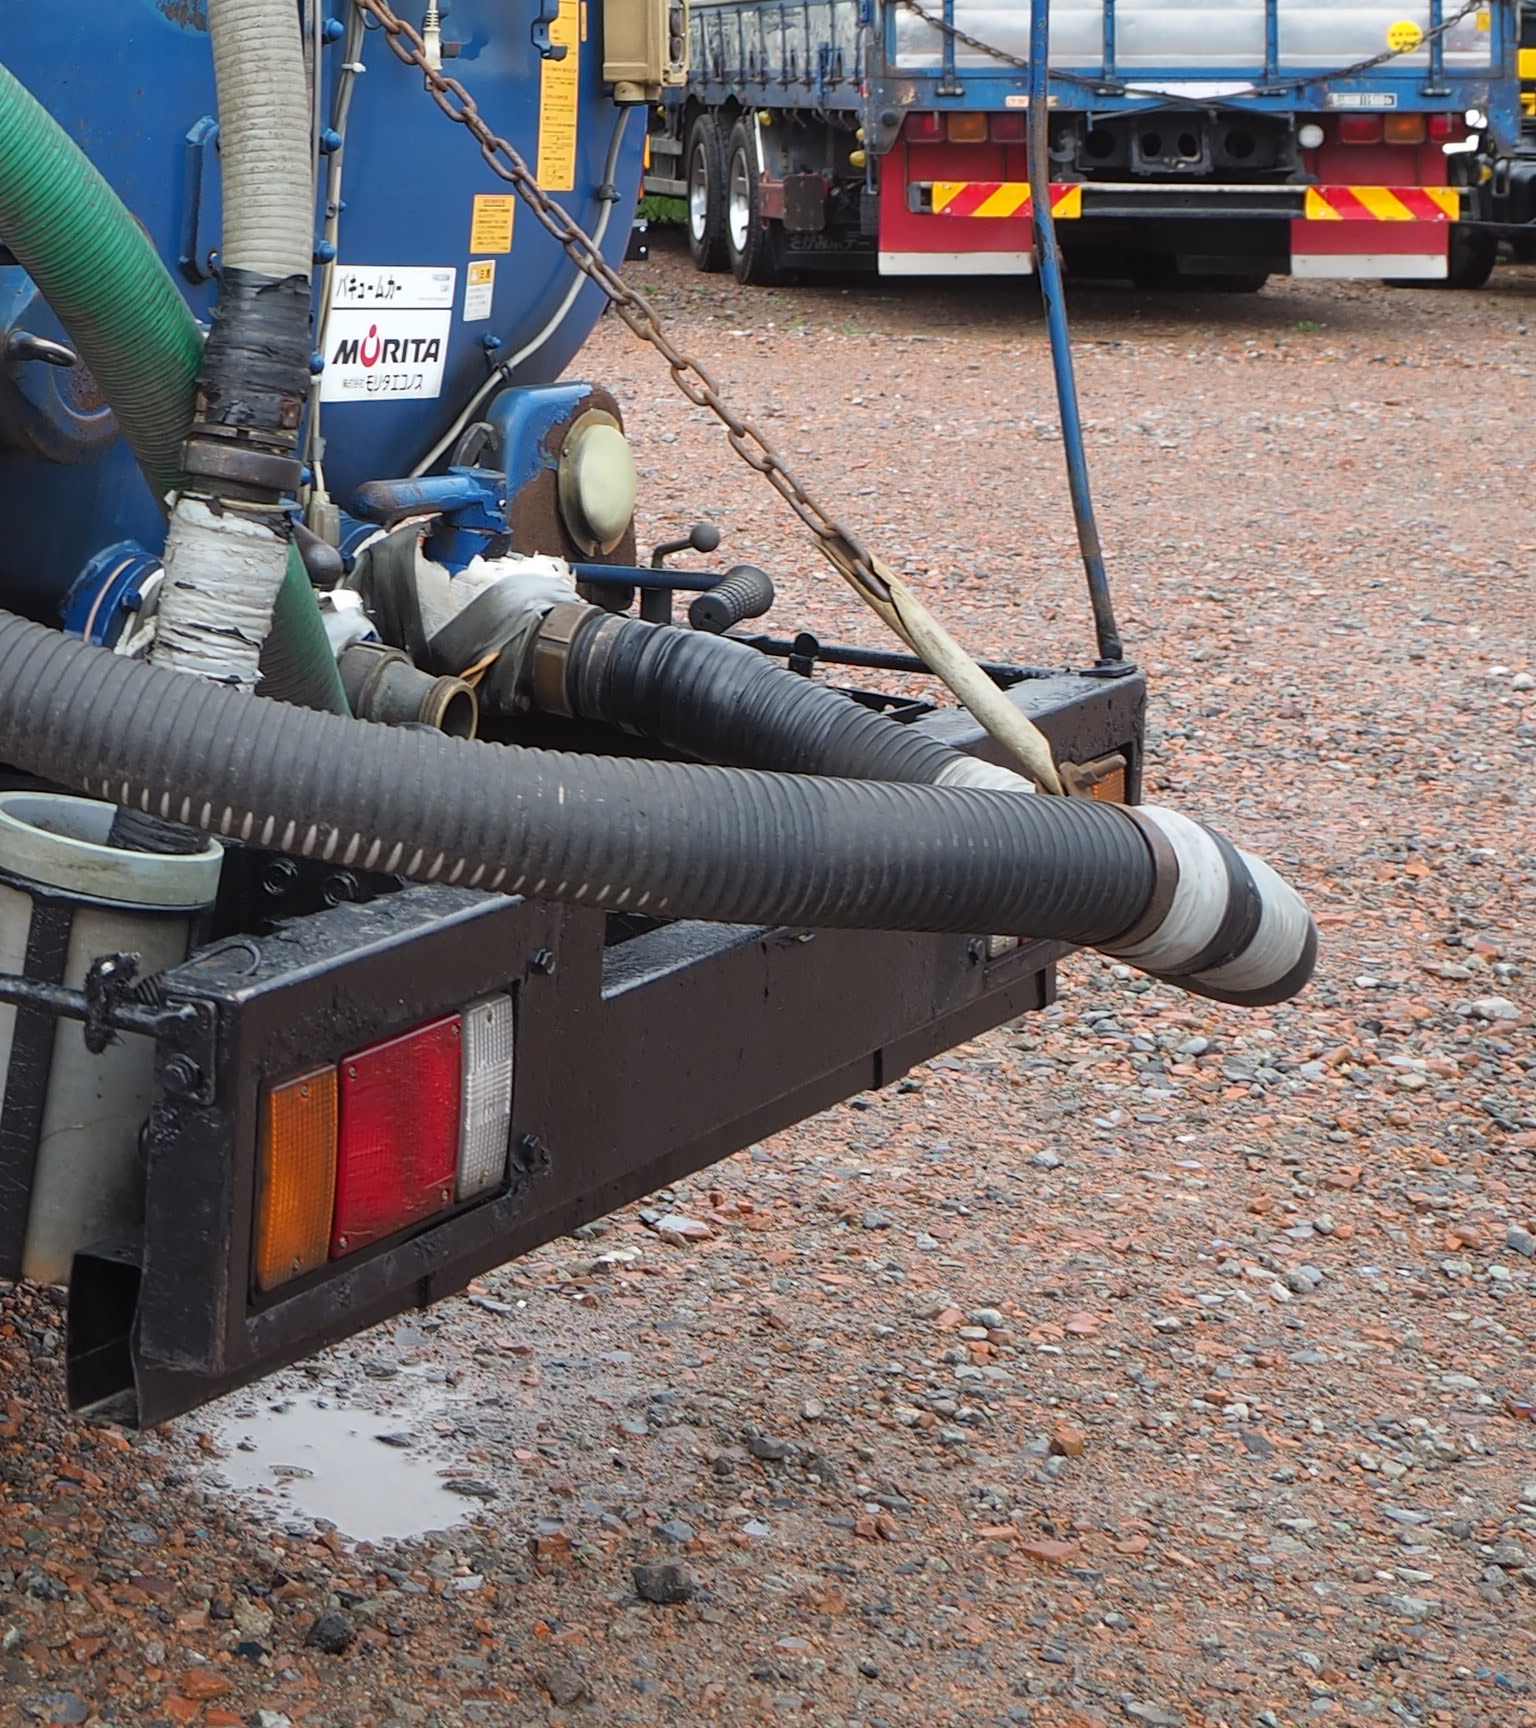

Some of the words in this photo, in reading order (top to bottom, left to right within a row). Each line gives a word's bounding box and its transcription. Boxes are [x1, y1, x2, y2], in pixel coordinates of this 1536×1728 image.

[336, 274, 402, 300] バキュームカー
[332, 324, 441, 368] MORITA
